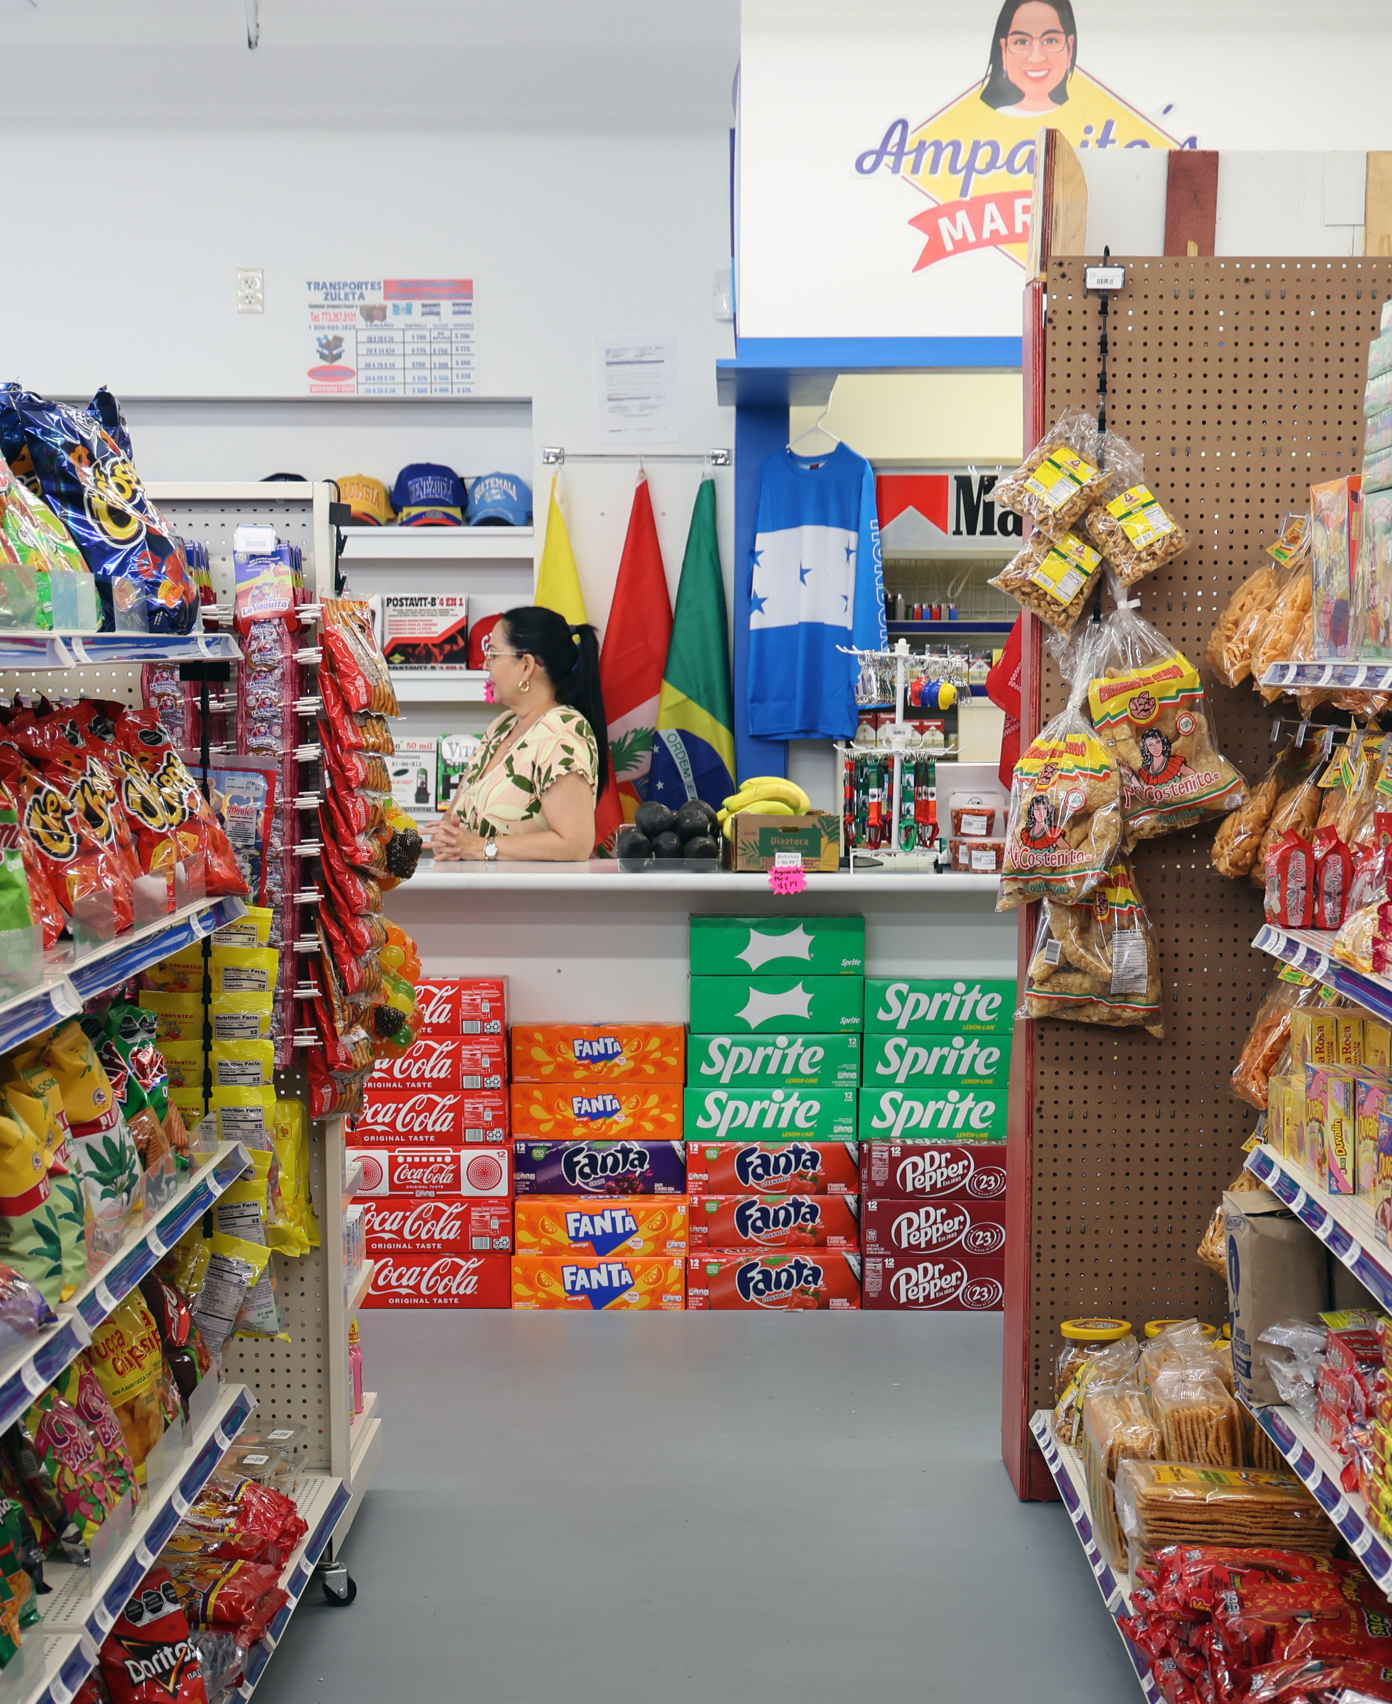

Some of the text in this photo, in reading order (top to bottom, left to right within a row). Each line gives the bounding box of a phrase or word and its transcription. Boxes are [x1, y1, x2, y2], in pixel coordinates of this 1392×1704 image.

[306, 281, 381, 290] TRANSPORTES
[324, 291, 365, 301] ZULETA
[310, 312, 320, 322] Tel:
[475, 477, 517, 505] GUATEMALA
[250, 599, 288, 614] Vaquita
[387, 597, 436, 607] POSTAVIT-B
[440, 597, 444, 606] 4
[446, 597, 456, 606] EN
[407, 742, 432, 750] 50 mil
[667, 733, 695, 795] ORDEM E
[1125, 771, 1214, 809] Mi Costeñita
[770, 836, 809, 845] Diazteca
[1019, 849, 1086, 870] Costeñita
[840, 958, 861, 967] Sprite
[876, 982, 1003, 1030] Sprite
[839, 1016, 860, 1025] Sprite
[573, 1037, 622, 1058] FANTA
[1315, 1025, 1324, 1054] Rosa
[1342, 1025, 1352, 1055] Rosa
[699, 1035, 825, 1084] Sprite
[875, 1036, 1001, 1084] Sprite
[572, 1094, 621, 1114] FANTA
[696, 1089, 821, 1137] Sprite
[871, 1090, 997, 1137] Sprite
[689, 1144, 699, 1152] 12
[393, 1162, 457, 1185] Coca-Cola
[562, 1142, 650, 1185] Fanta
[735, 1143, 822, 1187] Fanta
[897, 1155, 968, 1193] Pepper
[924, 1150, 951, 1173] Dr
[588, 1178, 605, 1187] GRAPE
[979, 1175, 996, 1190] 23
[566, 1209, 637, 1237] FANTA
[735, 1196, 821, 1240] Fanta
[919, 1206, 947, 1228] Dr
[892, 1212, 964, 1249] Pepper
[975, 1231, 992, 1246] 23
[562, 1262, 635, 1291] FANTA
[736, 1258, 823, 1301] Fanta
[891, 1268, 961, 1303] Pepper
[918, 1262, 945, 1285] Dr
[971, 1286, 989, 1300] 23
[84, 1328, 126, 1366] Yucca
[125, 1637, 203, 1688] Doritos
